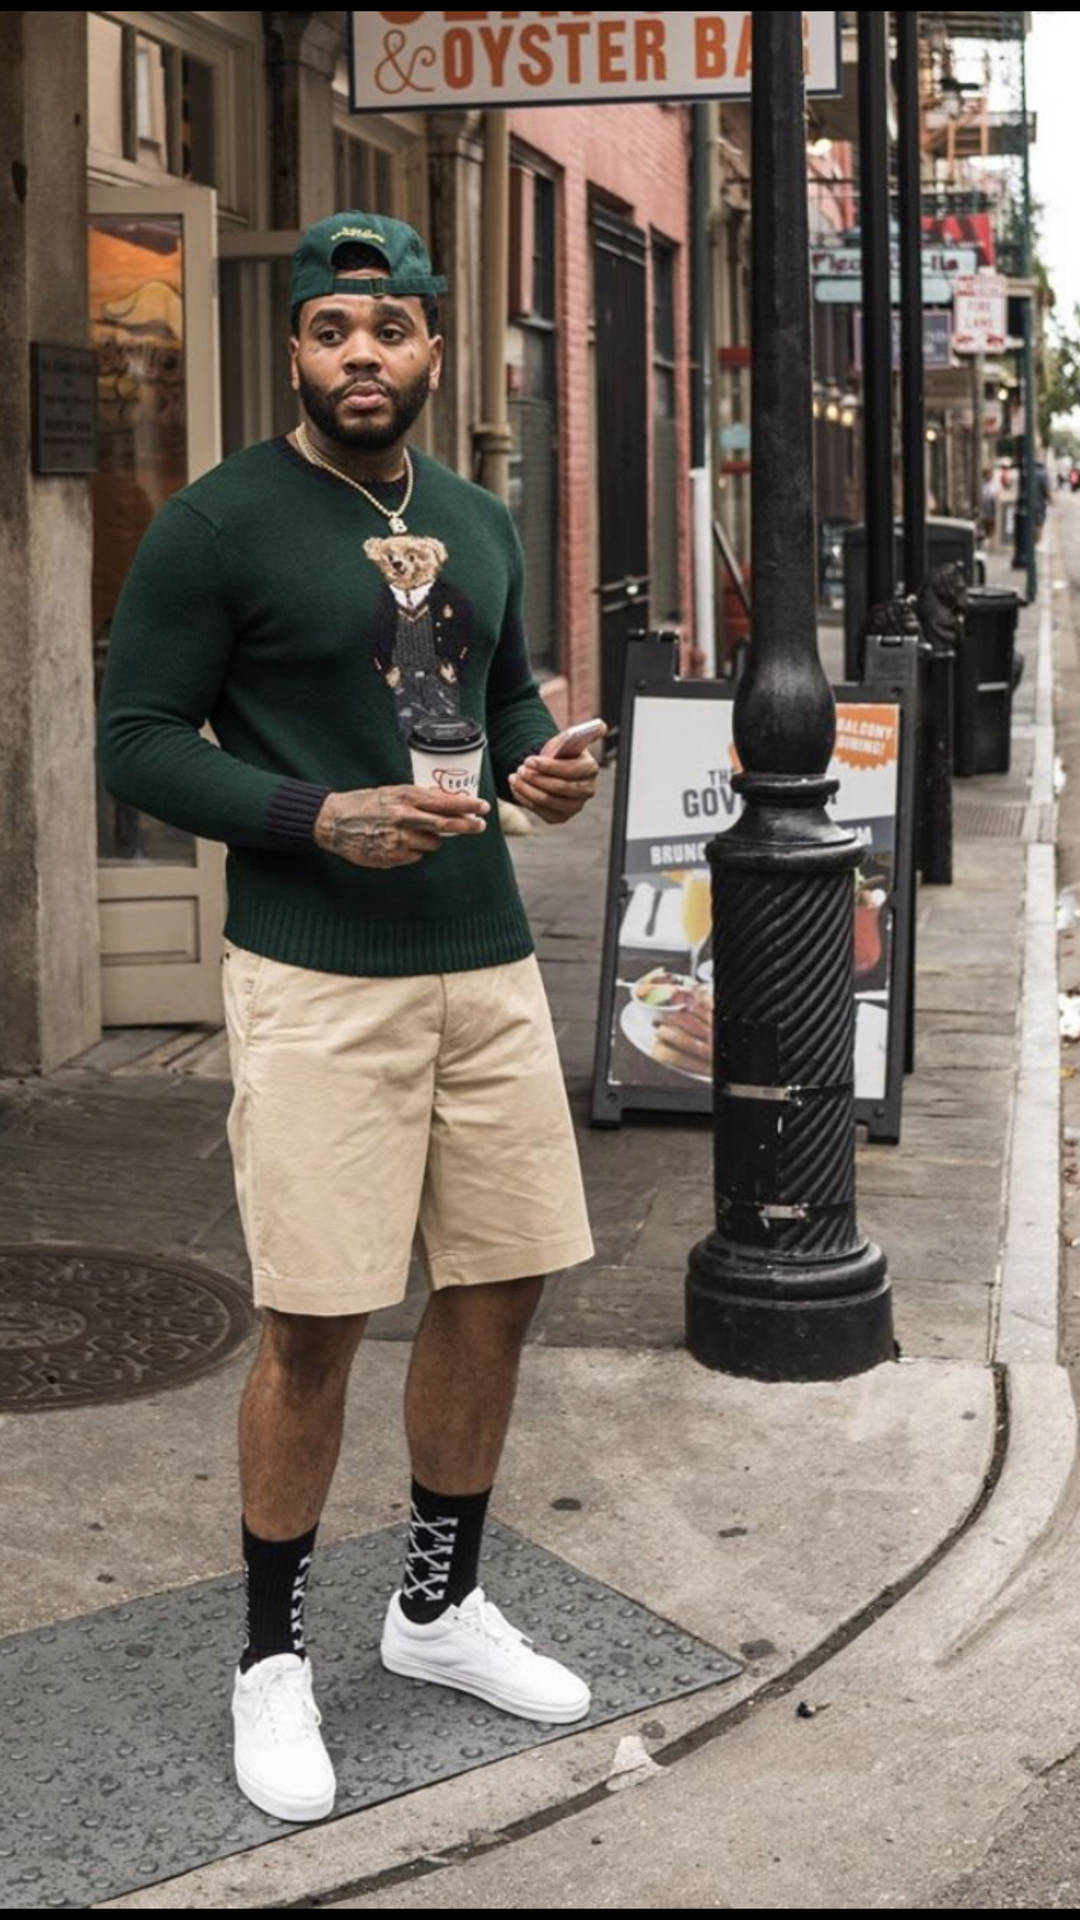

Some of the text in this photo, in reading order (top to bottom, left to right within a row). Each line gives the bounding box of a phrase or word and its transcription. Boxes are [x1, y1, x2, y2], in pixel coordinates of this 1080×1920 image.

[694, 13, 811, 80] BA
[708, 768, 737, 786] TH
[682, 786, 736, 818] GOV
[650, 842, 707, 866] BRUNC
